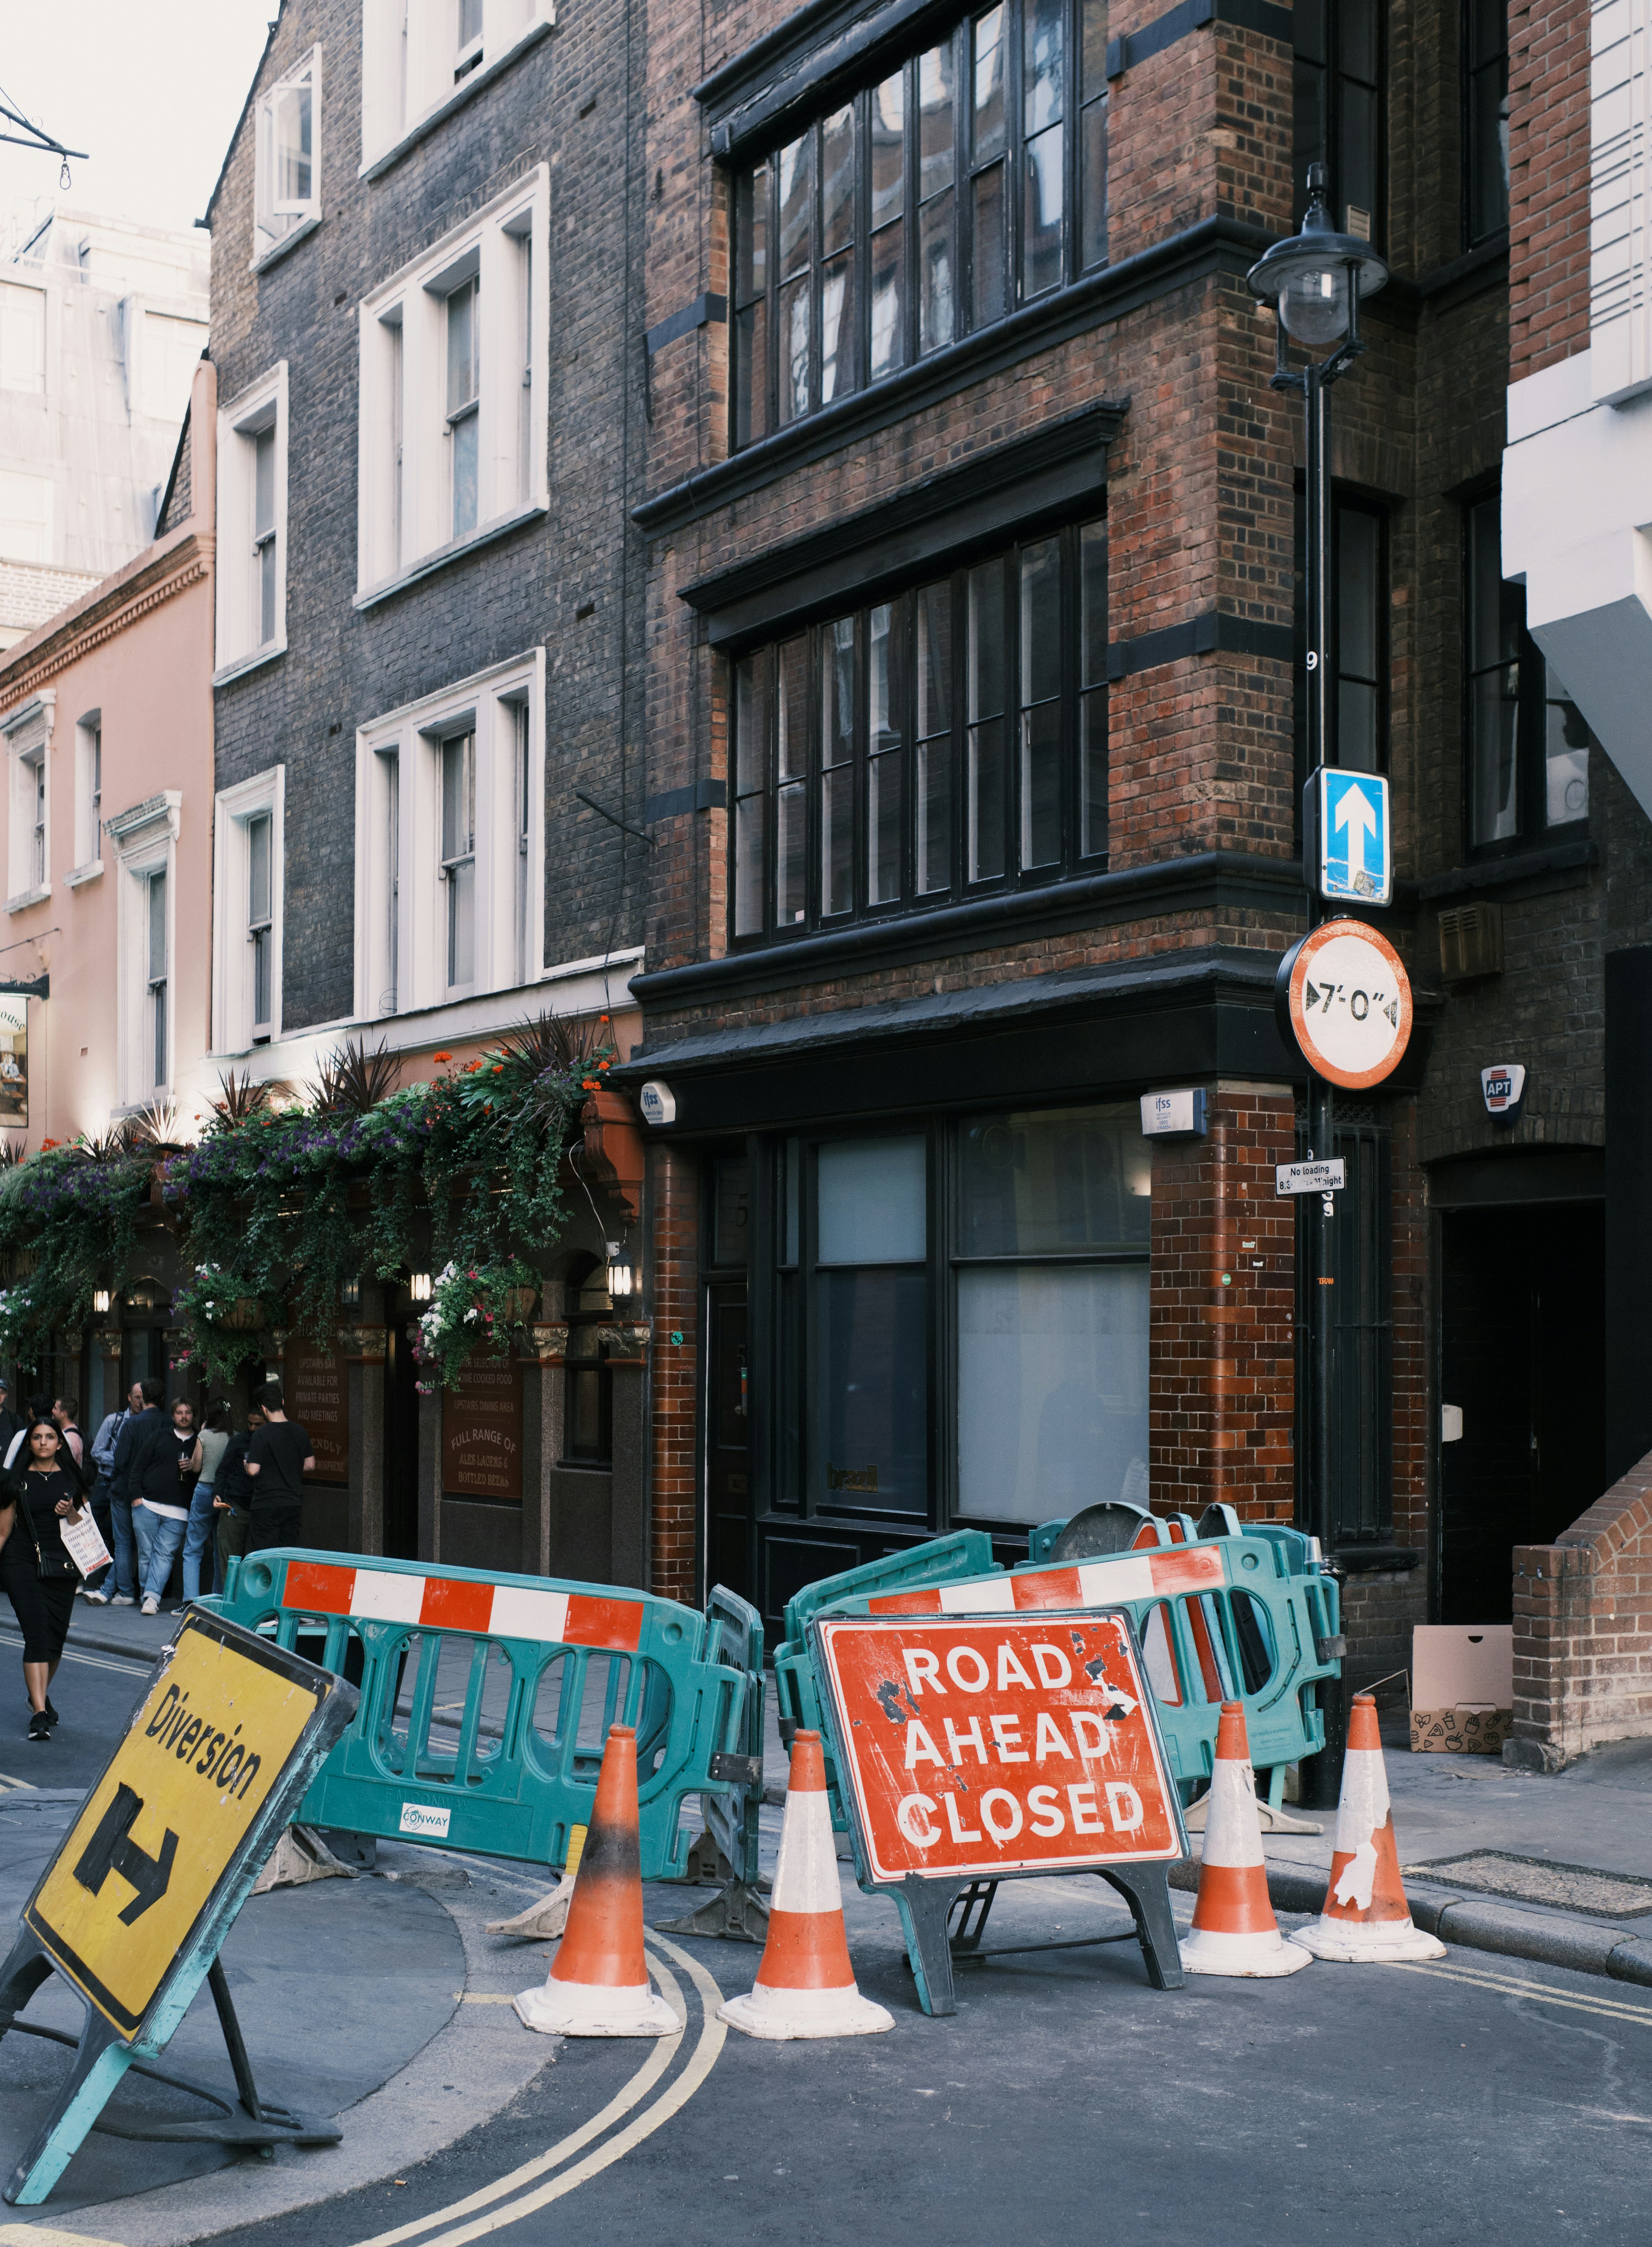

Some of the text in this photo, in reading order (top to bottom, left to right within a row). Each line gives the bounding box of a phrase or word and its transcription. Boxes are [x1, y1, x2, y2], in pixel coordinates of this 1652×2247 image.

[1307, 651, 1318, 670] 9
[0, 1011, 25, 1030] ouse
[1487, 1081, 1510, 1095] APT
[642, 1092, 658, 1108] ifss
[1156, 1098, 1171, 1112] ifss
[1291, 1165, 1329, 1176] No loading
[299, 1323, 336, 1337] HOUSE
[299, 1358, 336, 1369] UPSTAIRS BAR
[474, 1358, 501, 1368] SELECTION
[502, 1358, 510, 1369] OF
[297, 1375, 337, 1386] AVAILABLE FOR
[473, 1373, 495, 1383] COOKED
[497, 1374, 512, 1384] FOOD
[296, 1392, 339, 1404] PRIVATE PARTIES
[454, 1400, 514, 1412] UPSTAIRS DINING AREA
[298, 1409, 338, 1422] AND MEETINGS
[310, 1438, 341, 1455] ENDLY
[451, 1429, 516, 1454] FULL RANGE OF
[316, 1460, 344, 1472] MOSPHERE
[459, 1454, 475, 1465] ALES
[477, 1455, 502, 1467] LAGERS
[458, 1471, 509, 1487] BOTTLED BEERS
[902, 1644, 1072, 1695] ROAD
[145, 1683, 261, 1800] Diversion
[904, 1711, 1110, 1769] AHEAD
[403, 1813, 448, 1826] CONWAY
[897, 1781, 1144, 1848] CLOSED
